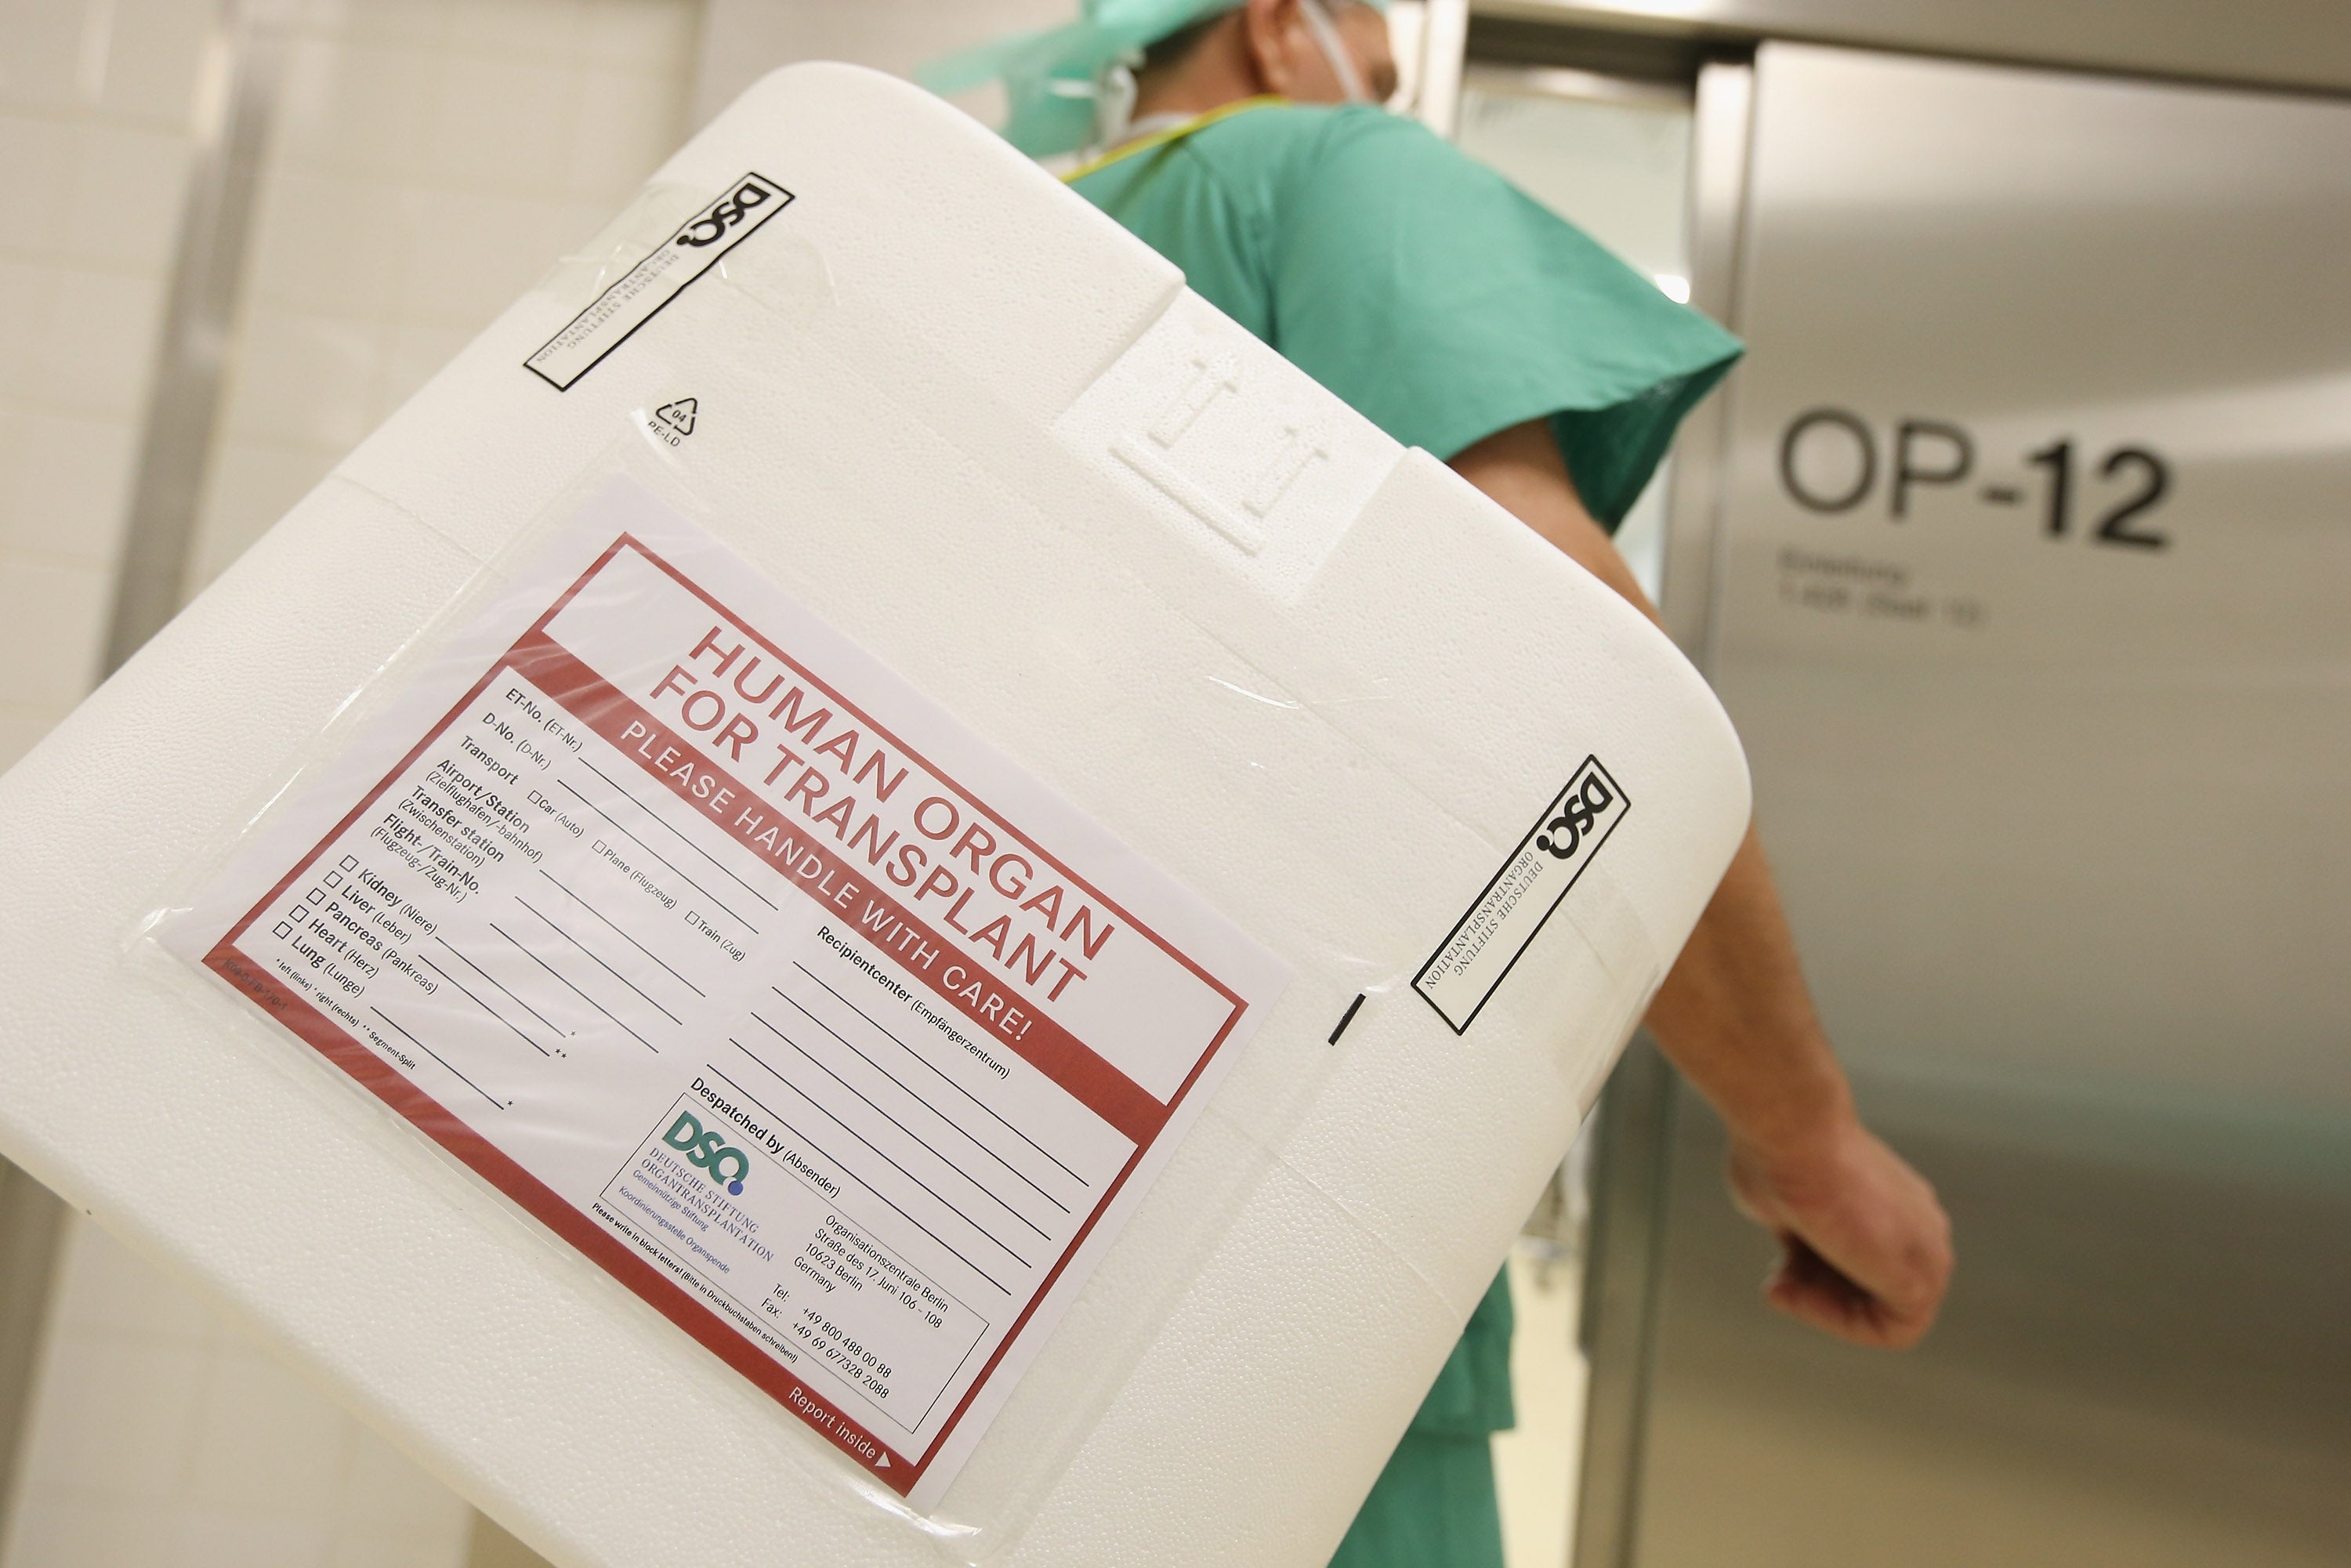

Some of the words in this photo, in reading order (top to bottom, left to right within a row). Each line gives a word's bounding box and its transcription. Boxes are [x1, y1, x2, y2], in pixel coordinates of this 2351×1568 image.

[567, 302, 621, 349] STIFTUNG
[648, 421, 680, 447] PE-LD
[672, 410, 686, 422] 04
[1777, 408, 2171, 555] OP-12
[482, 712, 514, 744] D-No.
[516, 739, 552, 771] (D-Nr.)
[505, 688, 542, 722] ET-No.
[543, 718, 583, 753] (ET-Nr.)
[398, 798, 486, 868] (Zwischenstation)
[411, 784, 462, 828] Transfer
[460, 827, 505, 863] station
[426, 770, 543, 864] (Zielflughafen/-bahnhof)
[437, 759, 530, 834] Airport/Station
[649, 664, 759, 763] FOR
[763, 743, 1088, 1003] TRANSPLANT
[688, 625, 910, 804] HUMAN
[913, 796, 1115, 961] ORGAN
[370, 826, 467, 904] (Flugzeug-/Zug-Nr.)
[383, 813, 479, 894] Flight-/Train-No.
[461, 735, 519, 785] Transport
[538, 799, 557, 815] Car
[554, 813, 585, 838] (Auto)
[603, 849, 631, 873] Plane
[629, 870, 678, 910] (Flugzeug)
[697, 919, 721, 943] Train
[719, 939, 746, 962] (Zug)
[620, 720, 736, 814] PLEASE
[734, 806, 860, 909] HANDLE
[861, 900, 940, 970] WITH
[943, 965, 1032, 1041] CARE!
[341, 885, 376, 914] Liver
[371, 911, 412, 945] (Leber)
[357, 868, 403, 907] Kidney
[399, 904, 438, 936] (Niere)
[1425, 851, 1534, 990] ORGANTRANSPLANTATION
[1500, 860, 1544, 920] DEUTSCHE
[291, 935, 326, 969] Lung
[323, 962, 365, 998] (Lunge)
[308, 918, 348, 953] Heart
[343, 948, 379, 980] (Herz)
[324, 901, 383, 951] Pancreas
[381, 947, 439, 996] (Pankreas)
[1454, 918, 1498, 976] STIFTUNG
[278, 961, 292, 975] left
[289, 971, 313, 991] (links)
[315, 992, 334, 1007] right
[331, 1003, 360, 1027] (rechts)
[368, 1031, 416, 1070] Segment-Split
[817, 925, 913, 1002] Recipientcenter
[911, 999, 1010, 1080] (Empfängerzentrum)
[690, 1077, 769, 1141] Despatched
[766, 1134, 785, 1155] by
[782, 1150, 841, 1199] (Absender)
[618, 1186, 686, 1240] Koordinierungsstelle
[686, 1237, 730, 1274] Organspende
[632, 1169, 682, 1210] Gemeinnützige
[681, 1206, 709, 1232] Stiftung
[641, 1158, 774, 1262] ORGANTRANSPLANTATION
[649, 1147, 706, 1193] DEUTSCHE
[705, 1190, 759, 1233] STIFTUNG
[592, 1202, 614, 1223] Please
[614, 1220, 632, 1237] write
[631, 1232, 639, 1242] in
[639, 1238, 659, 1257] block
[657, 1252, 684, 1275] letters!
[681, 1271, 700, 1288] (Bitte
[699, 1284, 707, 1294] in
[706, 1290, 762, 1336] Druckbuchstaben
[761, 1333, 799, 1363] schreiben!)
[794, 1256, 836, 1293] Germany
[806, 1243, 836, 1270] 10623
[835, 1265, 863, 1291] Berlin
[814, 1228, 846, 1256] Straße
[846, 1253, 864, 1270] des
[865, 1266, 879, 1282] 17.
[877, 1276, 900, 1295] Juni
[899, 1291, 918, 1309] 106
[924, 1311, 943, 1328] 108
[825, 1215, 921, 1291] Organisationszentrale
[921, 1286, 948, 1313] Berlin
[761, 1298, 782, 1319] Fax:
[793, 1322, 812, 1339] +49
[811, 1337, 827, 1350] 69
[825, 1348, 863, 1378] 677328
[862, 1374, 889, 1399] 2088
[773, 1283, 790, 1302] Tel:
[803, 1308, 822, 1324] +49
[821, 1321, 842, 1341] 800
[842, 1338, 863, 1356] 488
[861, 1352, 878, 1367] 00
[876, 1363, 892, 1378] 88
[788, 1386, 836, 1429] Report
[835, 1421, 875, 1459] inside
